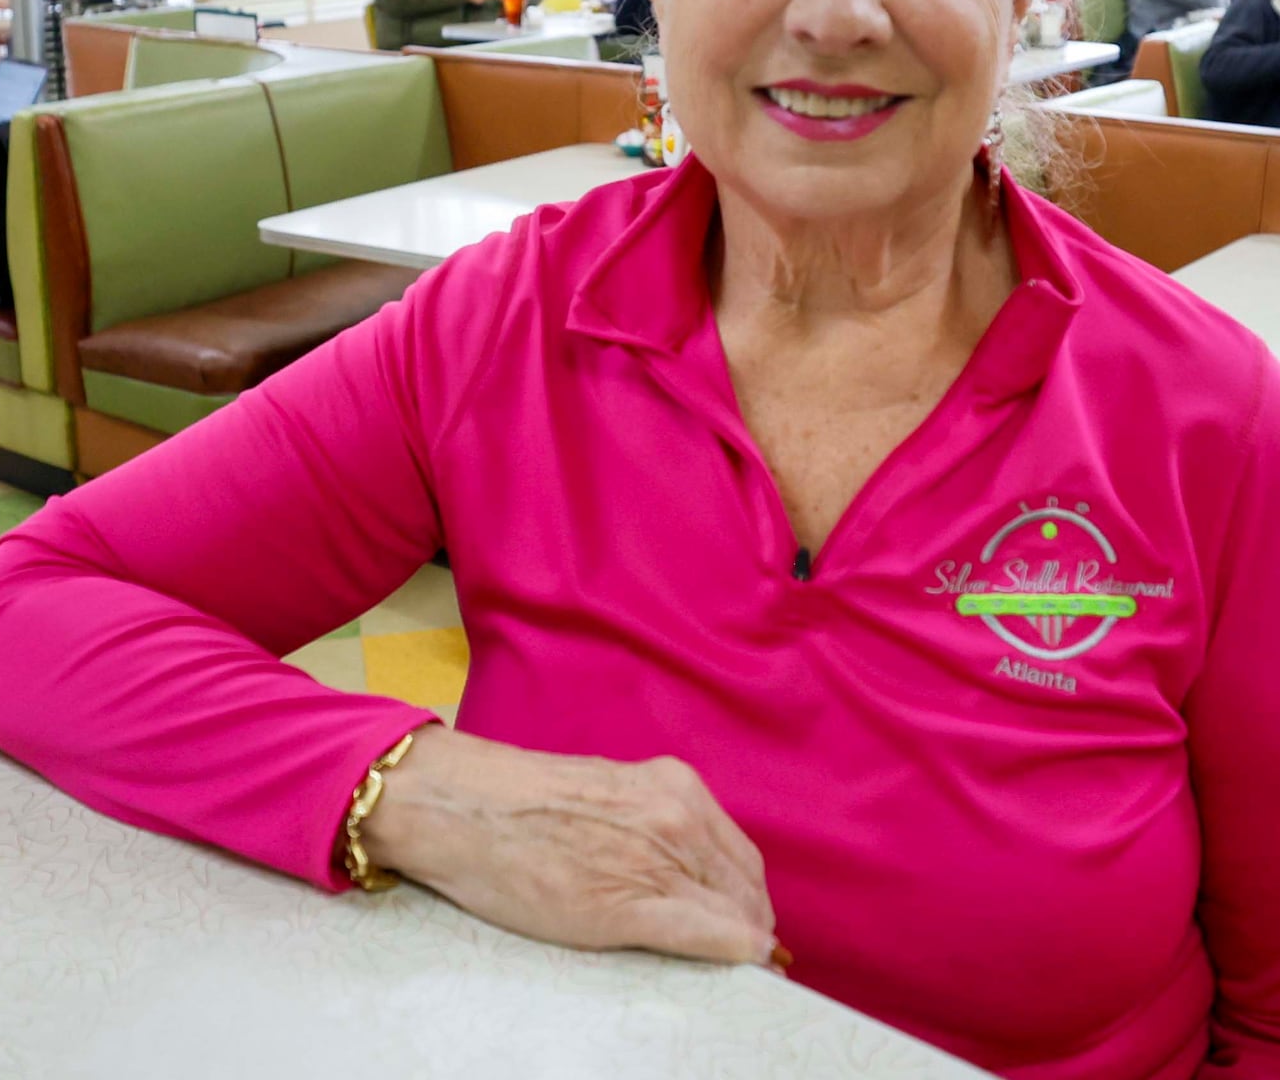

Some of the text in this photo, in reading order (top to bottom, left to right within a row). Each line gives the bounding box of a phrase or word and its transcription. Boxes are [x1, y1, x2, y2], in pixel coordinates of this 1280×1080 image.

[923, 558, 1175, 598] Silver Skillet Restaurant
[993, 655, 1077, 694] Atlanta
